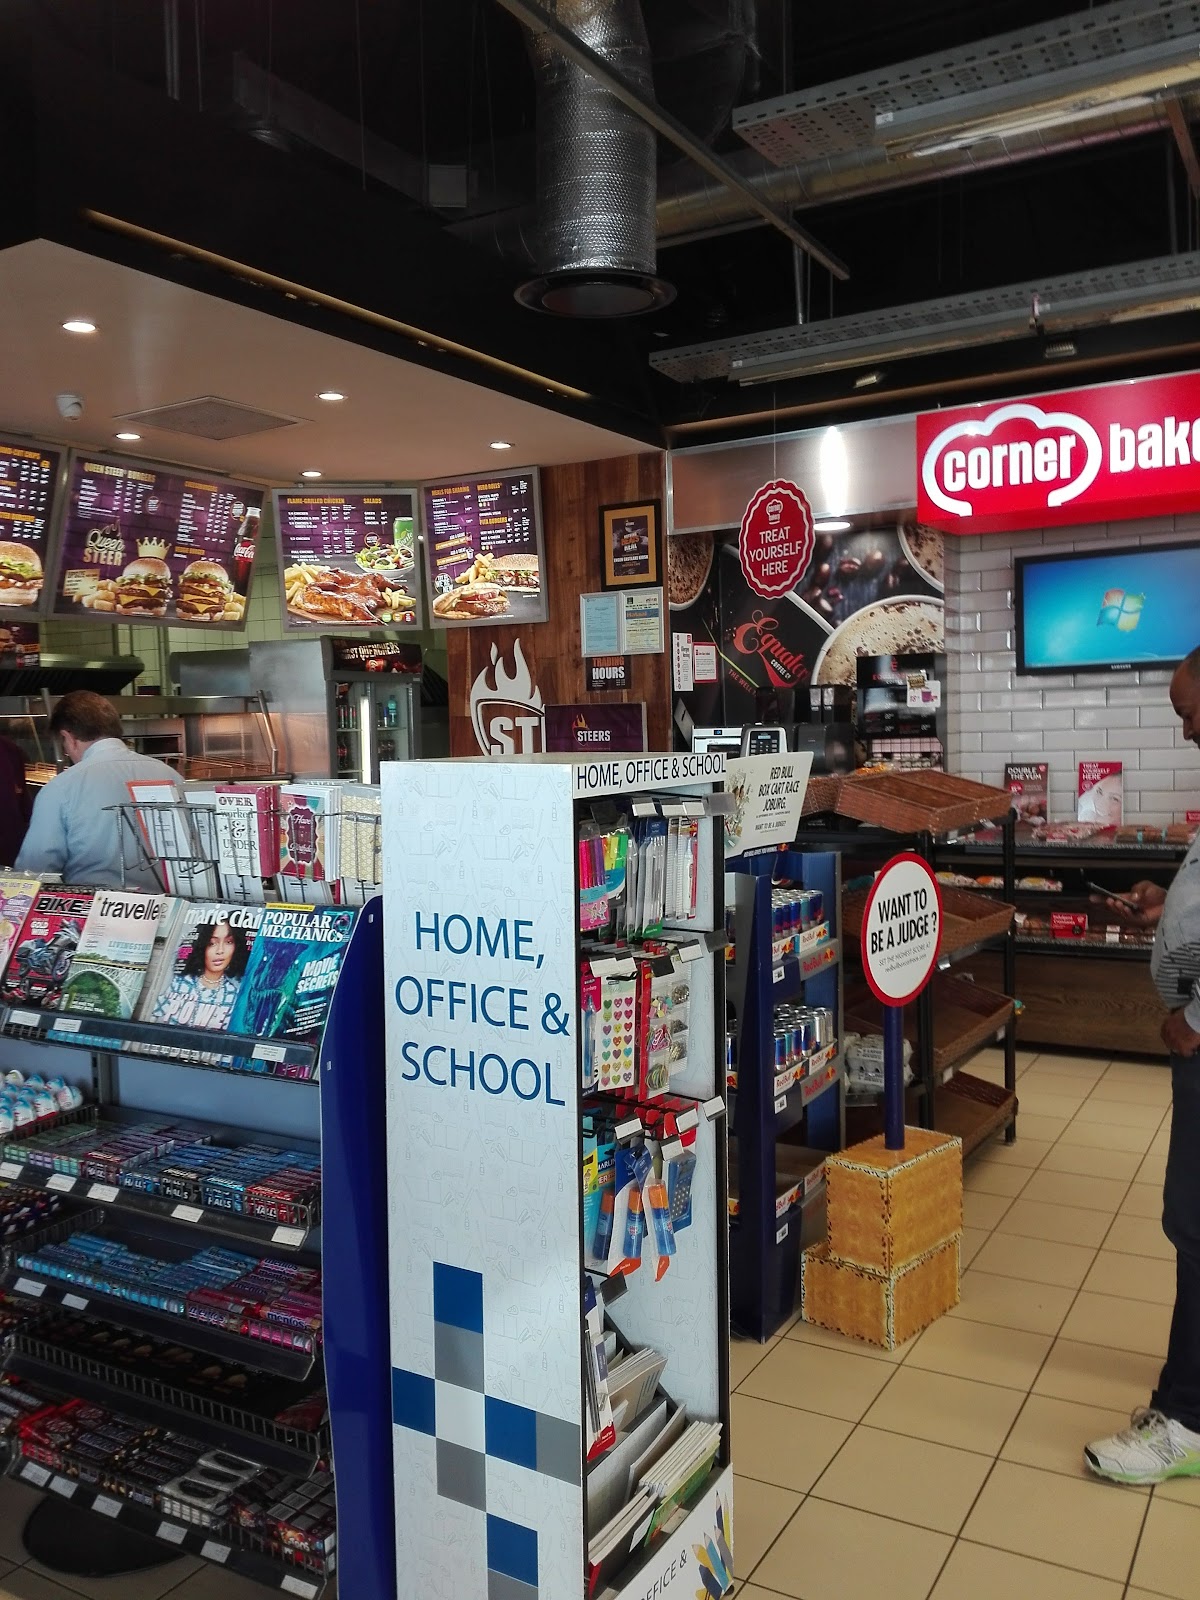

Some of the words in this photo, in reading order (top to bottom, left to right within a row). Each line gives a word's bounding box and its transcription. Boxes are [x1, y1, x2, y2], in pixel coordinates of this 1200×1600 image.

[943, 434, 1077, 492] corner
[127, 470, 156, 483] BURGERS
[87, 528, 125, 552] Queen
[759, 526, 791, 545] TREAT
[83, 547, 123, 566] STEER
[749, 540, 803, 562] YOURSELF
[761, 560, 789, 576] HERE
[592, 656, 625, 667] TRADING
[770, 659, 787, 676] COFFEE
[592, 666, 625, 680] HOURS
[728, 669, 738, 680] THE
[739, 677, 753, 692] WELL
[577, 730, 611, 742] STEERS
[577, 761, 624, 790] HOME,
[625, 757, 670, 783] OFFICE
[671, 757, 681, 778] &
[682, 753, 727, 778] SCHOOL
[770, 767, 780, 780] RED
[780, 766, 794, 779] BULL
[1008, 766, 1037, 774] DOUBLE
[758, 783, 770, 797] BOX
[770, 781, 785, 796] CART
[785, 780, 800, 794] RACE
[218, 796, 254, 807] OVER
[220, 807, 254, 819] worked
[293, 813, 313, 825] Have
[231, 820, 246, 839] &
[223, 838, 258, 851] UNDER
[184, 903, 228, 926] marie
[878, 893, 912, 924] WANT
[913, 888, 927, 912] TO
[263, 911, 332, 929] POPULAR
[259, 924, 344, 943] MECHANICS
[415, 911, 545, 970] HOME,
[871, 929, 884, 955] BE
[886, 926, 895, 950] A
[897, 914, 929, 946] JUDGE
[301, 953, 340, 978] MOVIE
[295, 970, 339, 995] SECRETS
[395, 975, 530, 1031] OFFICE
[541, 992, 570, 1036] &
[401, 1041, 566, 1107] SCHOOL
[267, 1311, 309, 1328] mentos
[679, 1549, 688, 1569] &
